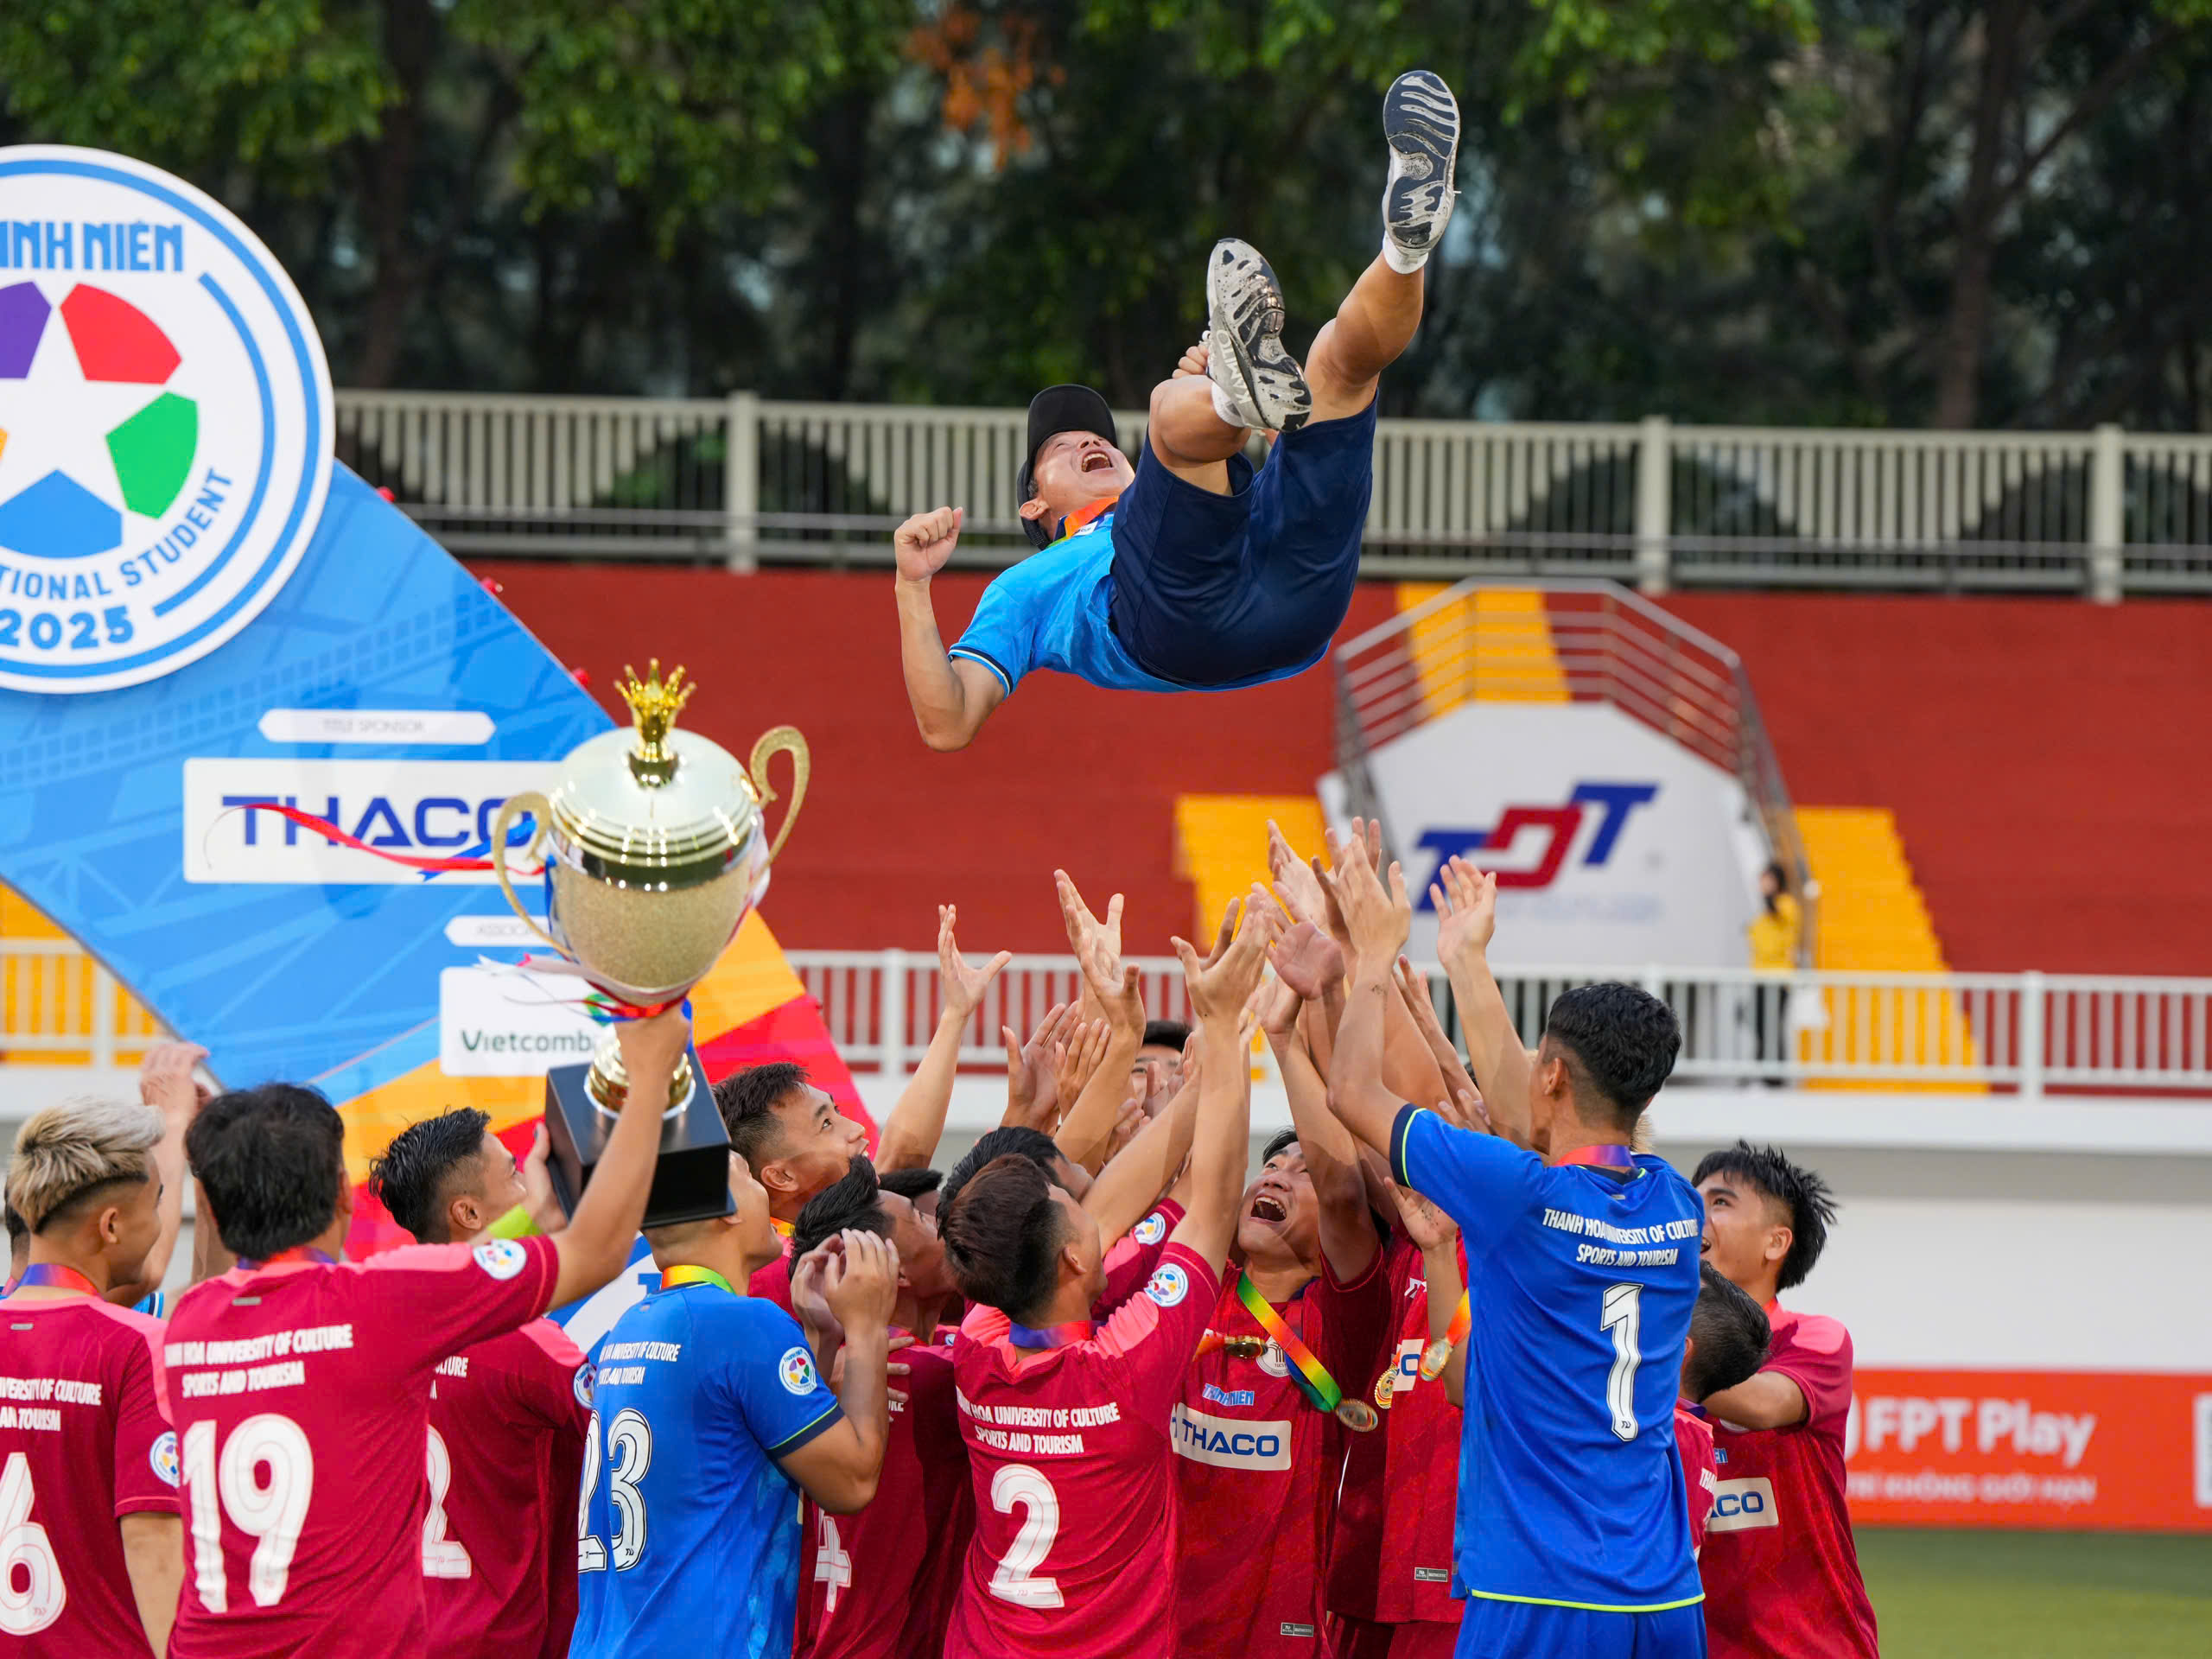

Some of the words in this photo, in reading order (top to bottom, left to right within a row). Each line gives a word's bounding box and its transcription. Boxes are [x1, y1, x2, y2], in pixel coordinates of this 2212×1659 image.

[83, 218, 182, 271] NIÊN
[119, 467, 233, 587] STUDENT
[0, 605, 134, 650] 2025
[461, 1029, 596, 1052] Vietcomb
[1542, 1208, 1584, 1234] THANH
[1585, 1218, 1606, 1239] HOA
[1649, 1224, 1666, 1243] OF
[1576, 1243, 1616, 1266] SPORTS
[1616, 1250, 1637, 1267] AND
[1637, 1249, 1679, 1267] TOURISM
[274, 1331, 293, 1357] OF
[292, 1324, 353, 1354] CULTURE
[645, 1341, 682, 1363] CULTURE
[247, 1360, 306, 1393] TOURISM
[1600, 1283, 1644, 1442] 1
[54, 1379, 103, 1406] CULTURE
[995, 1406, 1052, 1428] UNIVERSITY
[1052, 1409, 1069, 1428] OF
[1070, 1402, 1121, 1428] CULTURE
[1865, 1395, 1974, 1453] FPT
[1976, 1397, 2095, 1467] Play
[975, 1425, 1008, 1451] SPORTS
[1008, 1432, 1033, 1452] AND
[1033, 1433, 1085, 1454] TOURISM
[1182, 1418, 1280, 1457] THACO
[182, 1413, 315, 1614] 19
[988, 1455, 1065, 1610] 2
